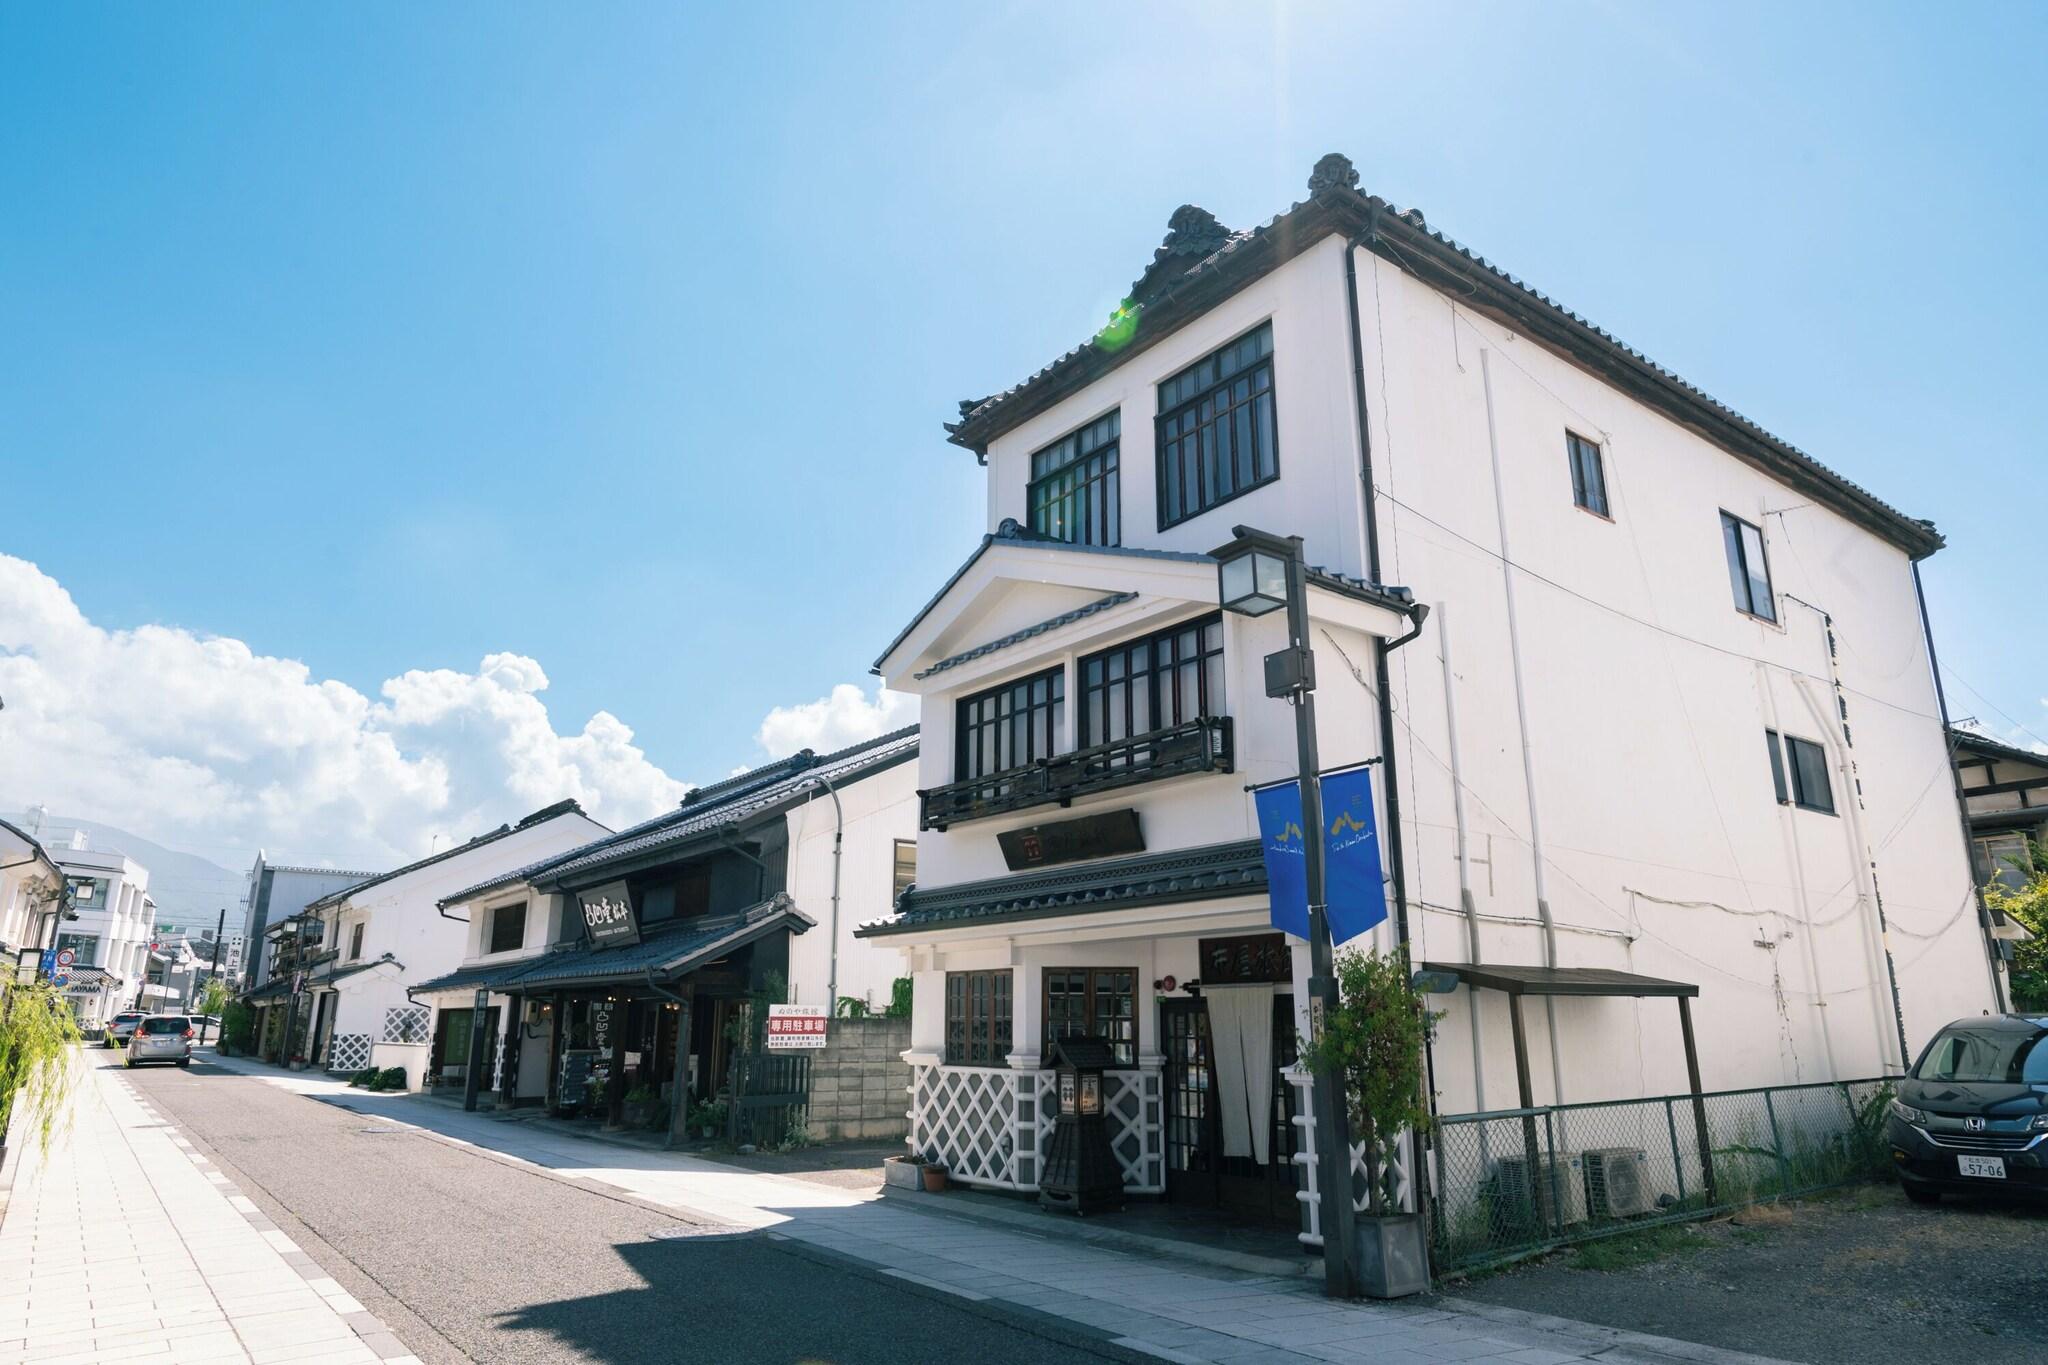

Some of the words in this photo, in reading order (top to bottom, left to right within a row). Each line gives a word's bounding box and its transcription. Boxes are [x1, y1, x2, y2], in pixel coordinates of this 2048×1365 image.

[771, 1019, 824, 1031] 専用駐車場
[1969, 1164, 2003, 1176] 57-06
